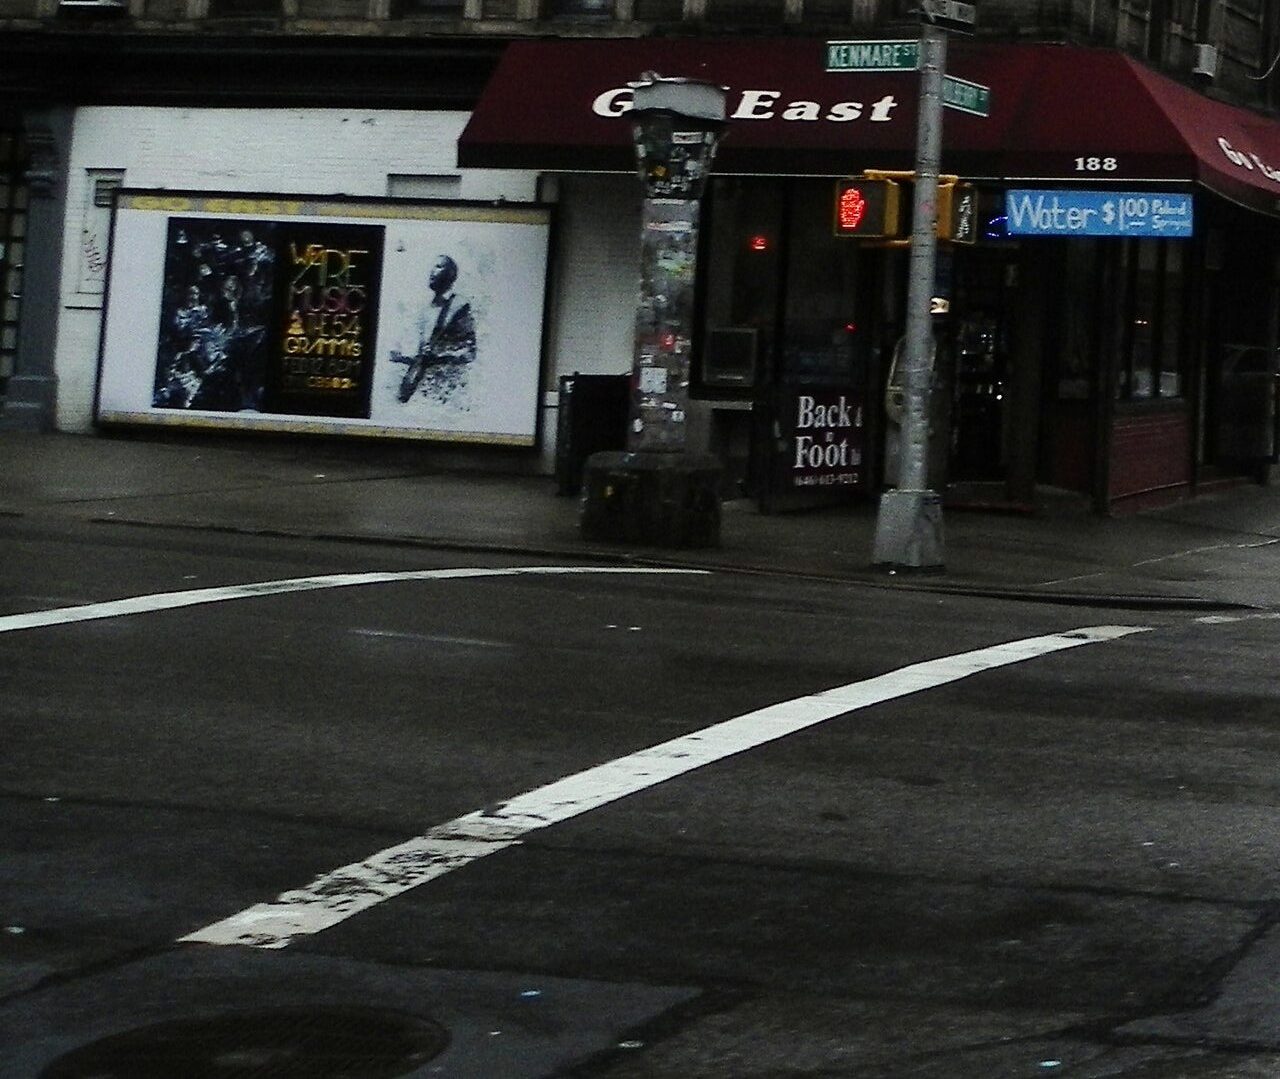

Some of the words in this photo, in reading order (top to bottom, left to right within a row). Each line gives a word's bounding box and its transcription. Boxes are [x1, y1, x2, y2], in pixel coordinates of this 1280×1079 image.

[829, 45, 901, 68] KENMARE
[730, 90, 898, 121] East
[1074, 157, 1118, 171] 188
[1007, 194, 1098, 230] Water
[797, 396, 851, 428] Back
[794, 436, 849, 468] Foot
